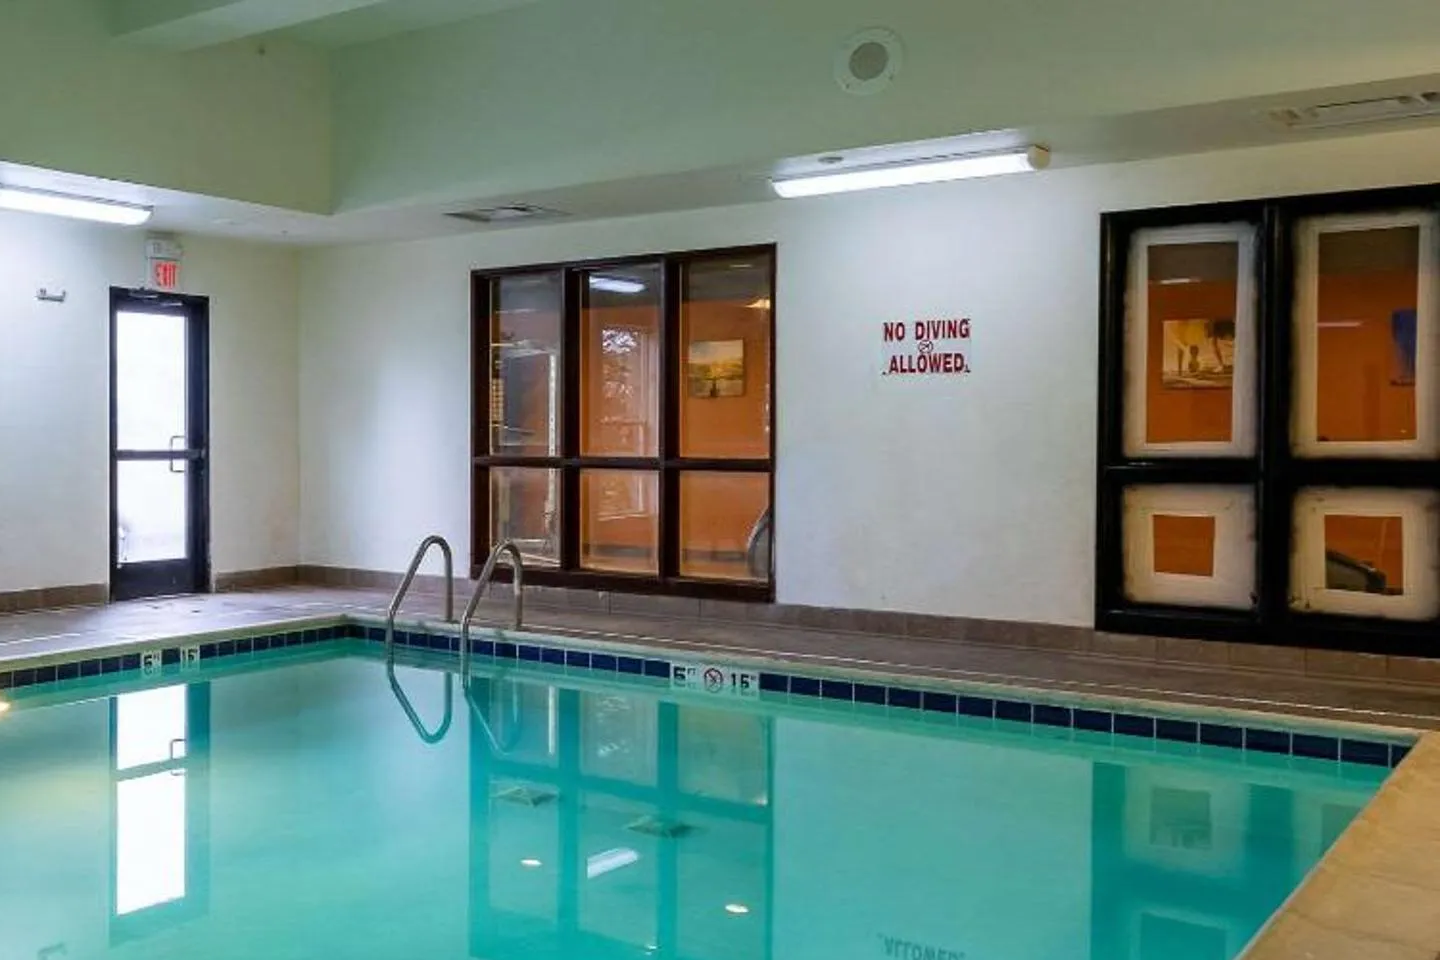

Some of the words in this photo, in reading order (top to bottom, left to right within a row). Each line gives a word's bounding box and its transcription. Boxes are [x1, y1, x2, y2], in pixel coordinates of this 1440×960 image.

[155, 262, 178, 287] EXIT
[883, 321, 906, 342] NO
[915, 318, 971, 341] DIVING
[888, 353, 965, 374] ALLOWED
